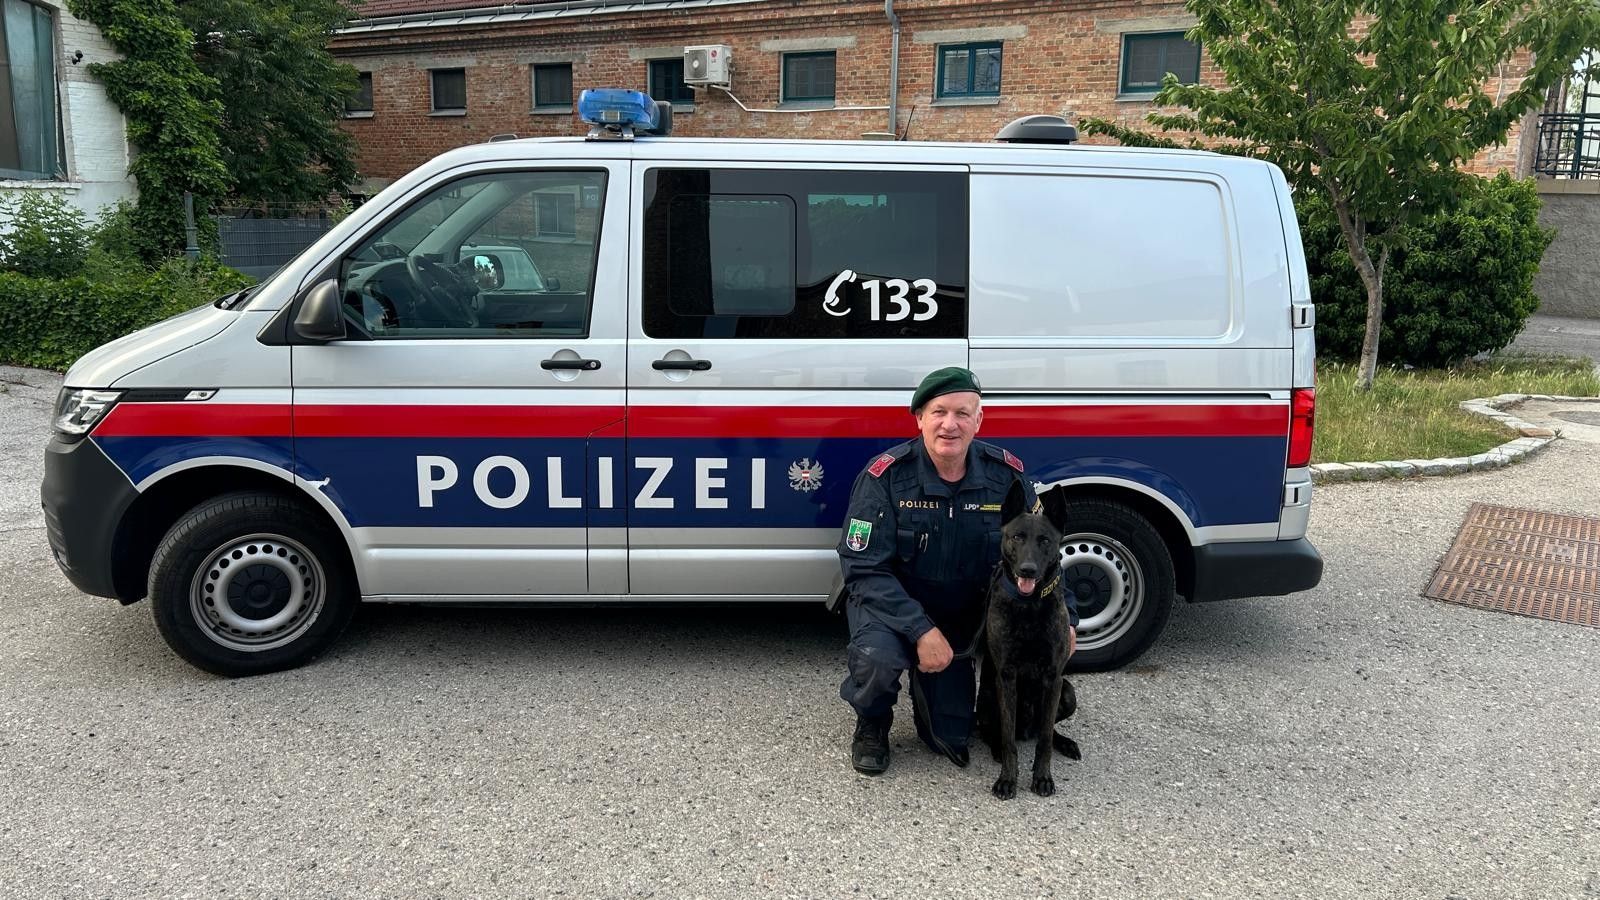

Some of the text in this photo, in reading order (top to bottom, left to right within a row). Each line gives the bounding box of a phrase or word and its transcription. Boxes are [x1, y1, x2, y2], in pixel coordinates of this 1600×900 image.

[862, 279, 938, 321] 133
[416, 455, 766, 509] POLIZEI
[899, 500, 939, 509] POLIZEI
